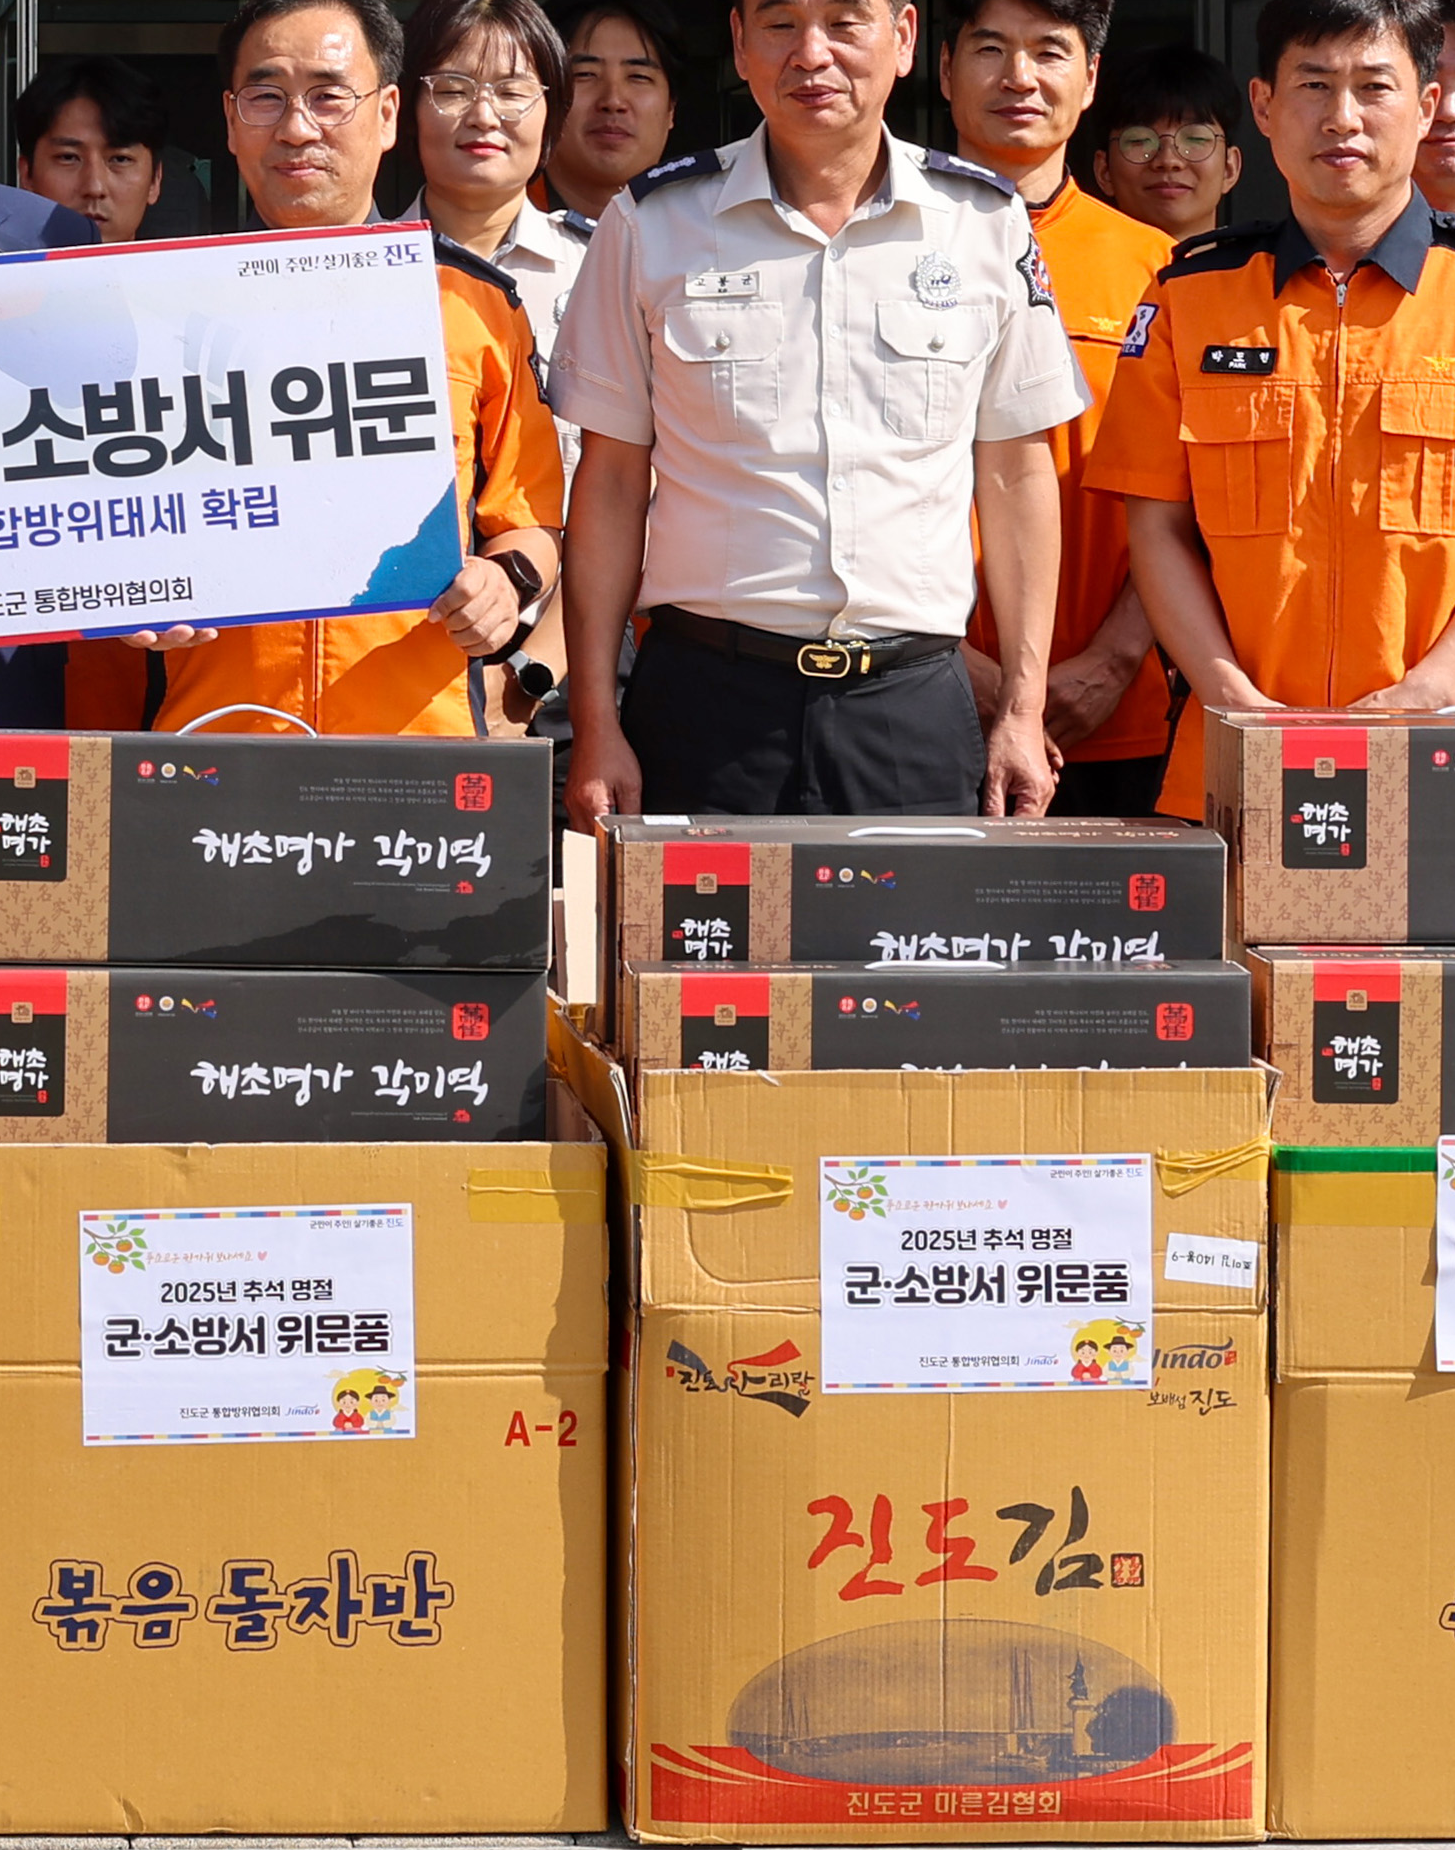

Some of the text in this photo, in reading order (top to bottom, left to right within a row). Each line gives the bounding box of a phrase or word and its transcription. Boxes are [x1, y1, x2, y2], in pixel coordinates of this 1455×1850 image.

[238, 243, 423, 277] 군민이 주인! 살기좋은 진도
[2, 369, 253, 482] 소방서
[270, 357, 436, 462] 위문
[202, 485, 279, 530] 확립
[35, 577, 192, 613] 통합방위협의회
[1299, 802, 1349, 821] 해초
[2, 834, 51, 856] 명가
[1304, 822, 1351, 844] 명가
[192, 829, 355, 875] 해초명가
[680, 918, 730, 937] 해초
[685, 938, 732, 960] 명가
[1330, 1036, 1381, 1055] 해초
[0, 1069, 48, 1091] 명가
[1335, 1056, 1383, 1078] 명가
[190, 1061, 353, 1106] 해초명가
[902, 1229, 1071, 1250] 2025년 추석 명절
[161, 1279, 332, 1302] 2025년 추석 명절
[846, 1264, 1128, 1304] 군·소방서 위문품
[106, 1314, 389, 1356] 군·소방서 위문품
[919, 1356, 949, 1368] 진도군
[951, 1355, 1020, 1368] 통합방위협의회
[179, 1407, 210, 1419] 진도군
[212, 1405, 281, 1419] 통합방위협의회
[1190, 1388, 1237, 1416] 진도
[504, 1411, 578, 1448] A-2
[807, 1485, 1103, 1601] 진도김
[36, 1554, 451, 1648] 볶음 돌자반
[846, 1789, 1061, 1816] 진도군 마른김협회
